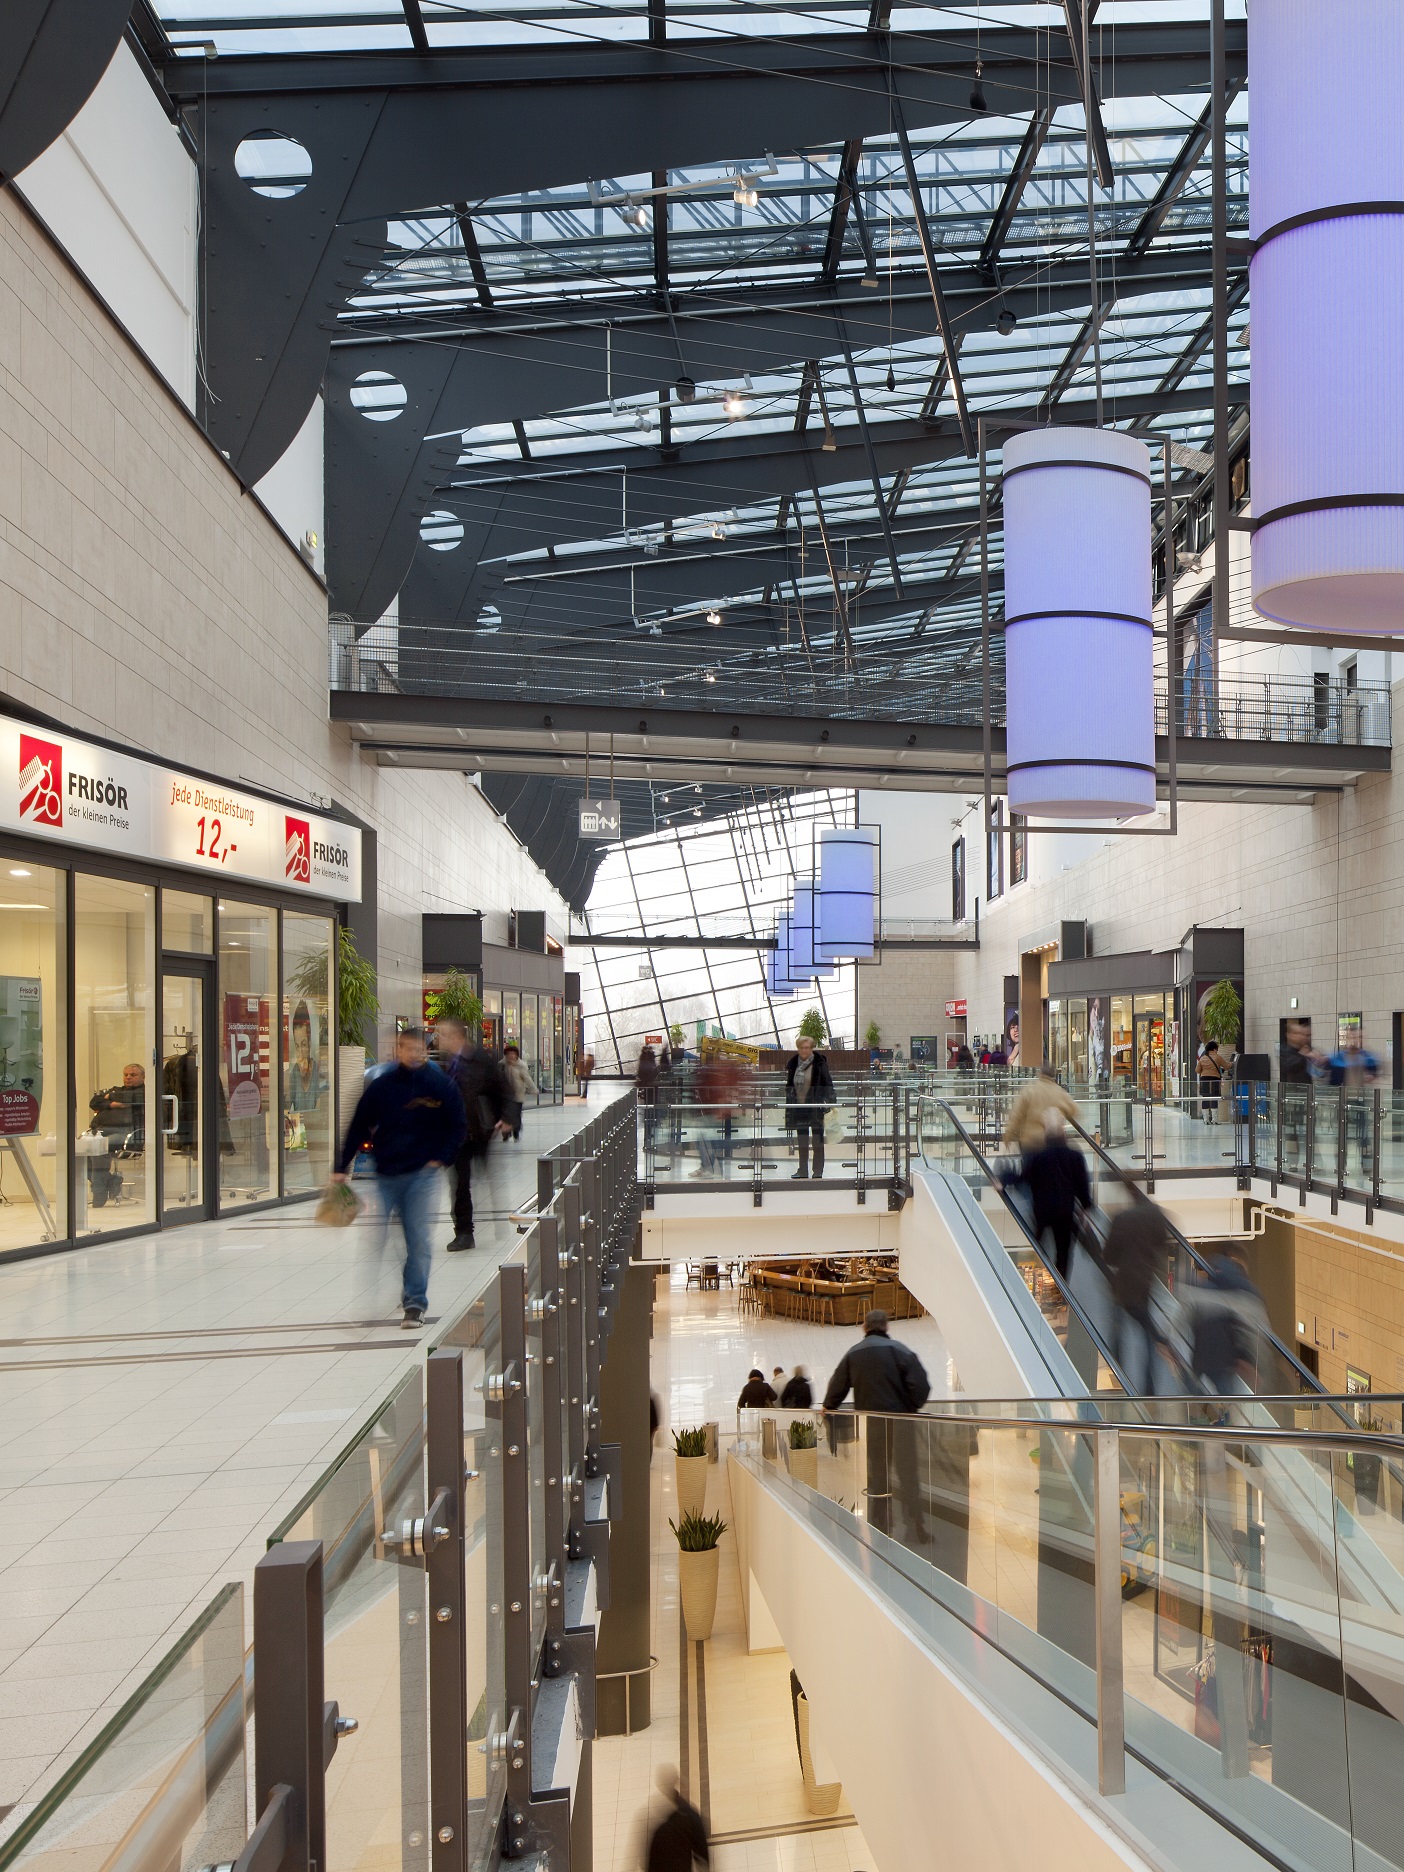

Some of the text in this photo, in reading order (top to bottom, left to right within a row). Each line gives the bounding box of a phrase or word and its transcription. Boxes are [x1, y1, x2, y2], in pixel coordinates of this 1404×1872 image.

[68, 771, 129, 811] FRISÖR
[170, 781, 255, 827] jede Dienstleistung
[68, 803, 130, 830] der kleinen Preise
[195, 816, 238, 864] 12,-
[313, 841, 349, 868] FRISÖR
